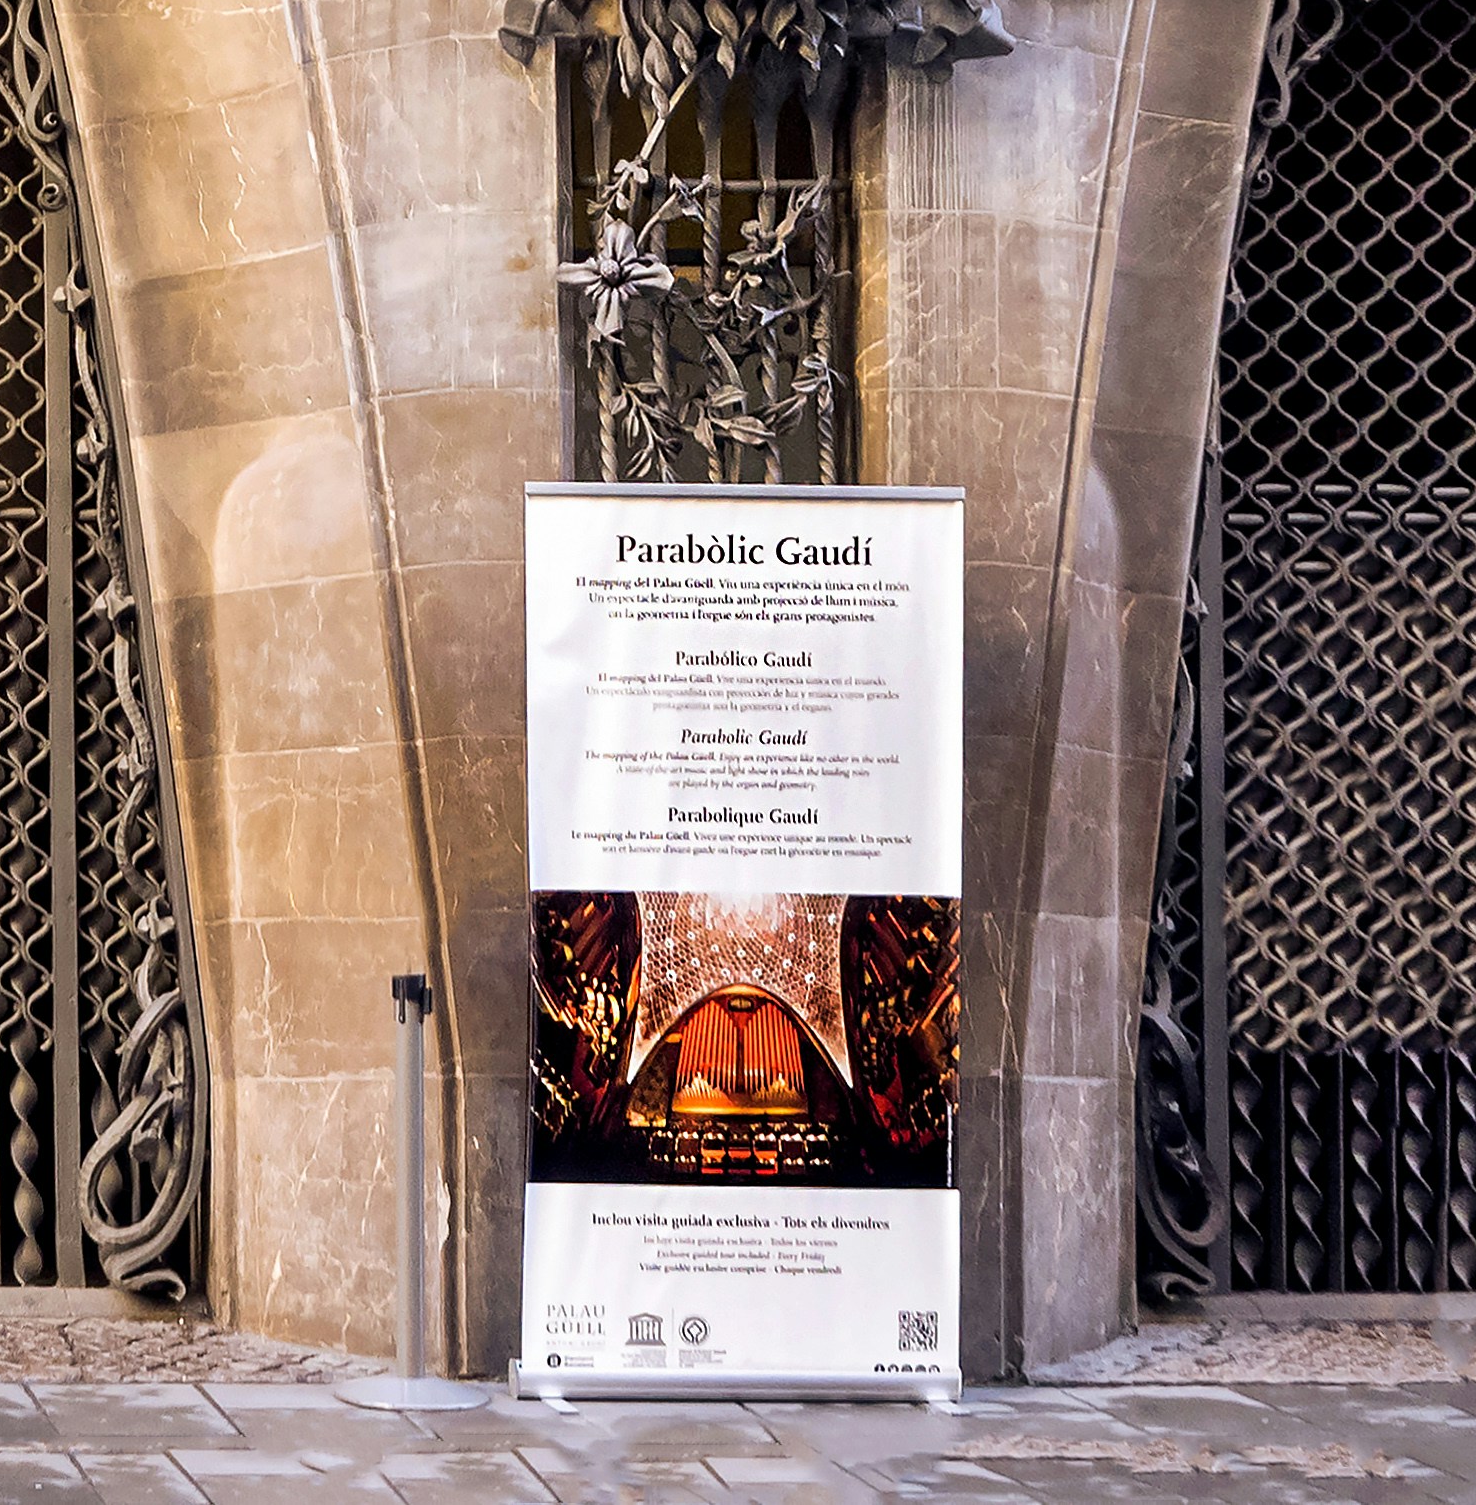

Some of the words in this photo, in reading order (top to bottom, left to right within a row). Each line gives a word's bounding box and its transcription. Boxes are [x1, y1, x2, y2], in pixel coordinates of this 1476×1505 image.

[616, 534, 764, 565] Parabòlic
[776, 536, 873, 566] Gaudí
[576, 577, 586, 587] El
[634, 578, 650, 588] del
[653, 578, 682, 588] Palau
[719, 578, 738, 589] Viu
[740, 581, 760, 589] una
[872, 580, 882, 590] el
[589, 593, 604, 603] Un
[736, 594, 760, 604] amb
[811, 595, 823, 605] de
[826, 595, 850, 605] llum
[625, 609, 634, 619] la
[676, 650, 758, 667] Parabólico
[763, 652, 812, 668] Gaudí
[681, 728, 753, 744] Parabolic
[758, 729, 808, 745] Gaudí
[668, 806, 764, 828] Parabolique
[769, 807, 818, 824] Gaudí
[592, 1213, 632, 1226] Inclou
[635, 1214, 668, 1226] visita
[672, 1215, 712, 1230] guiada
[716, 1214, 770, 1227] exclusiva
[781, 1216, 808, 1228] Tots
[810, 1216, 827, 1228] els
[831, 1217, 890, 1229] divendres
[547, 1304, 605, 1318] PALAU
